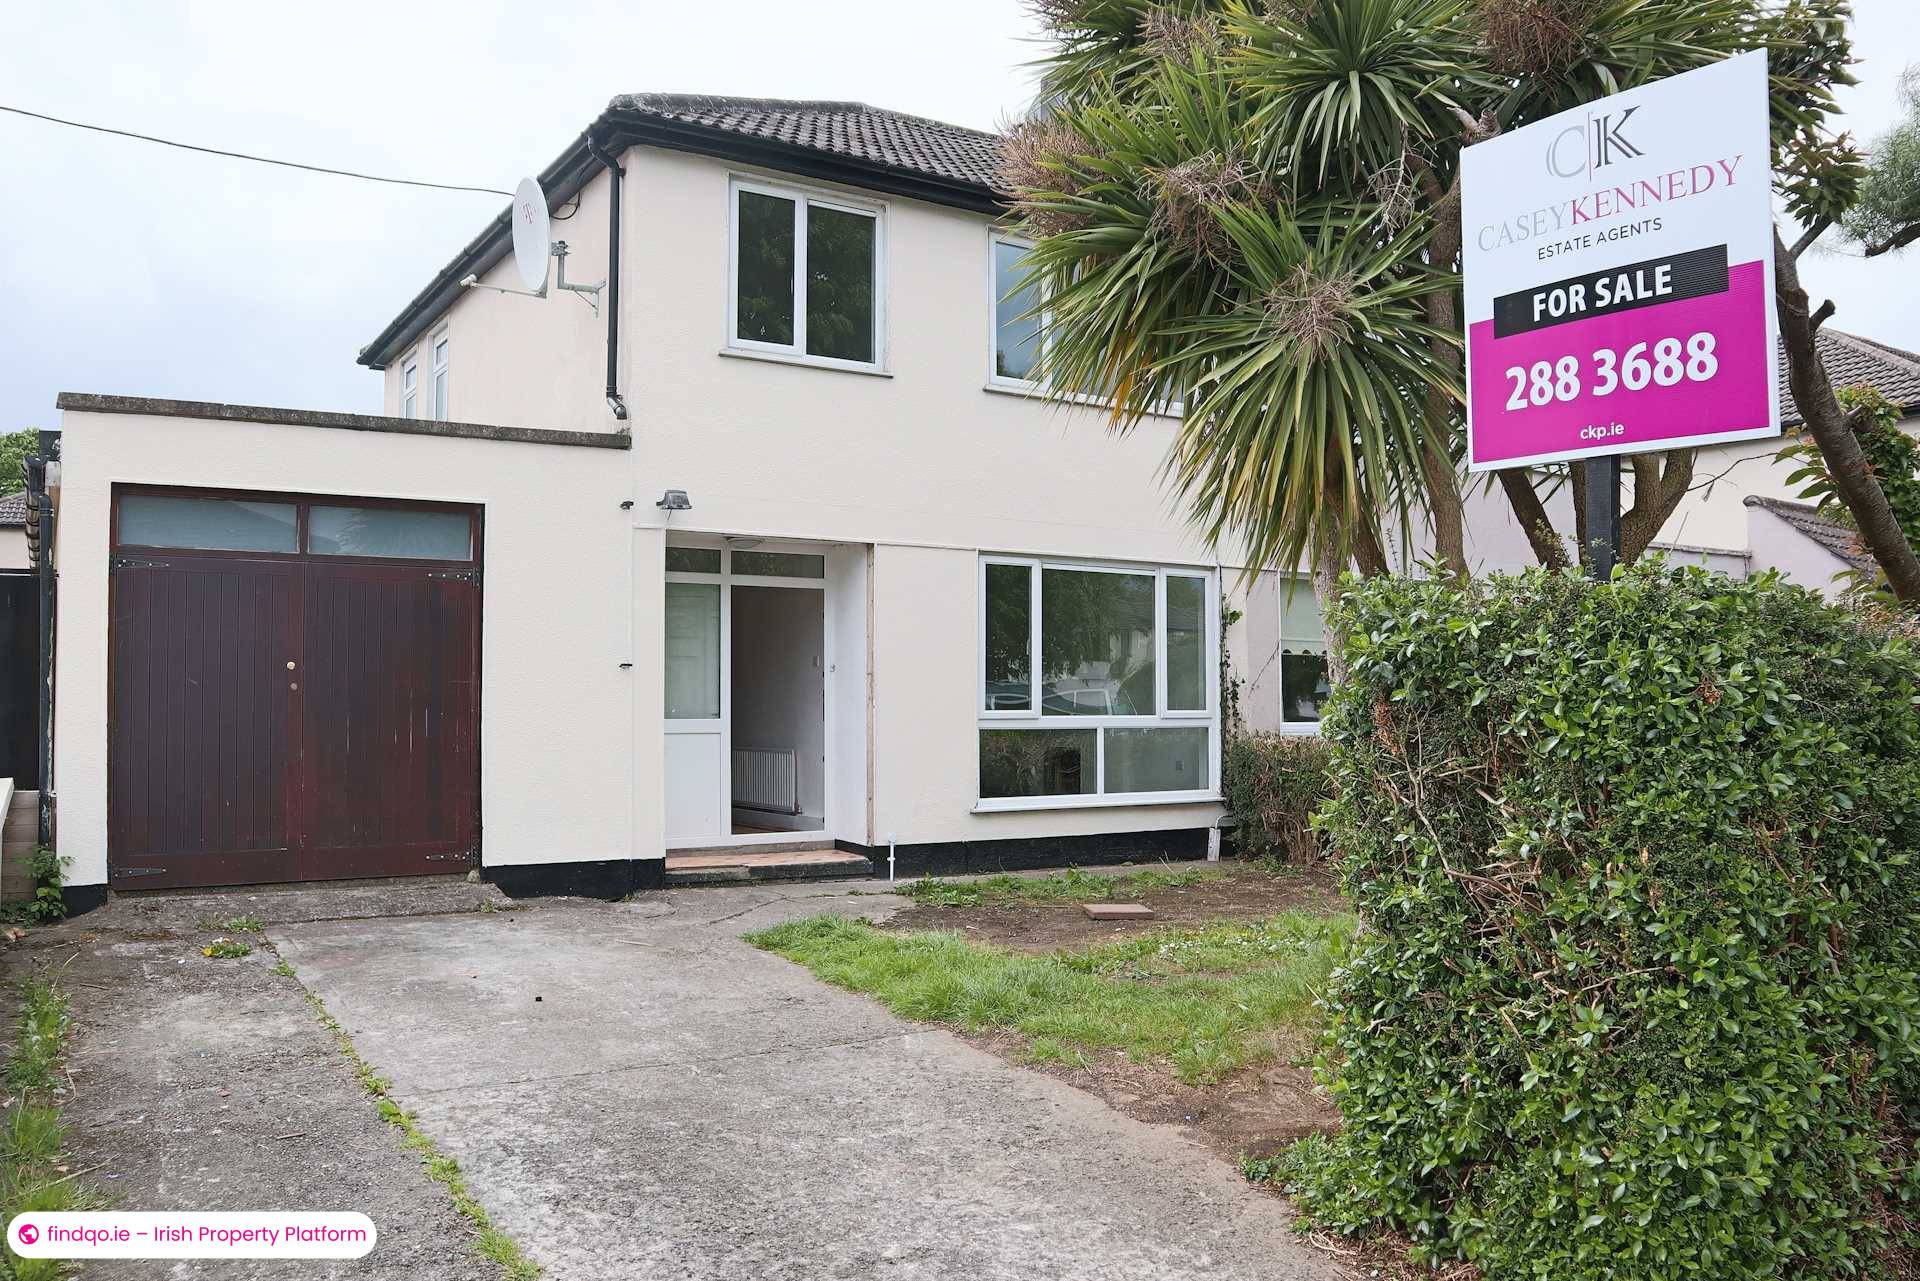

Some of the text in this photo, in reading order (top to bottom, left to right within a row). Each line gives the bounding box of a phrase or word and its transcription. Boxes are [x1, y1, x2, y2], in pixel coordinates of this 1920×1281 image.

[1537, 217, 1663, 260] ESTATE AGENTS
[1533, 264, 1673, 322] FOR SALE
[1505, 332, 1718, 411] 288 3688
[1580, 422, 1625, 440] ckp.ie
